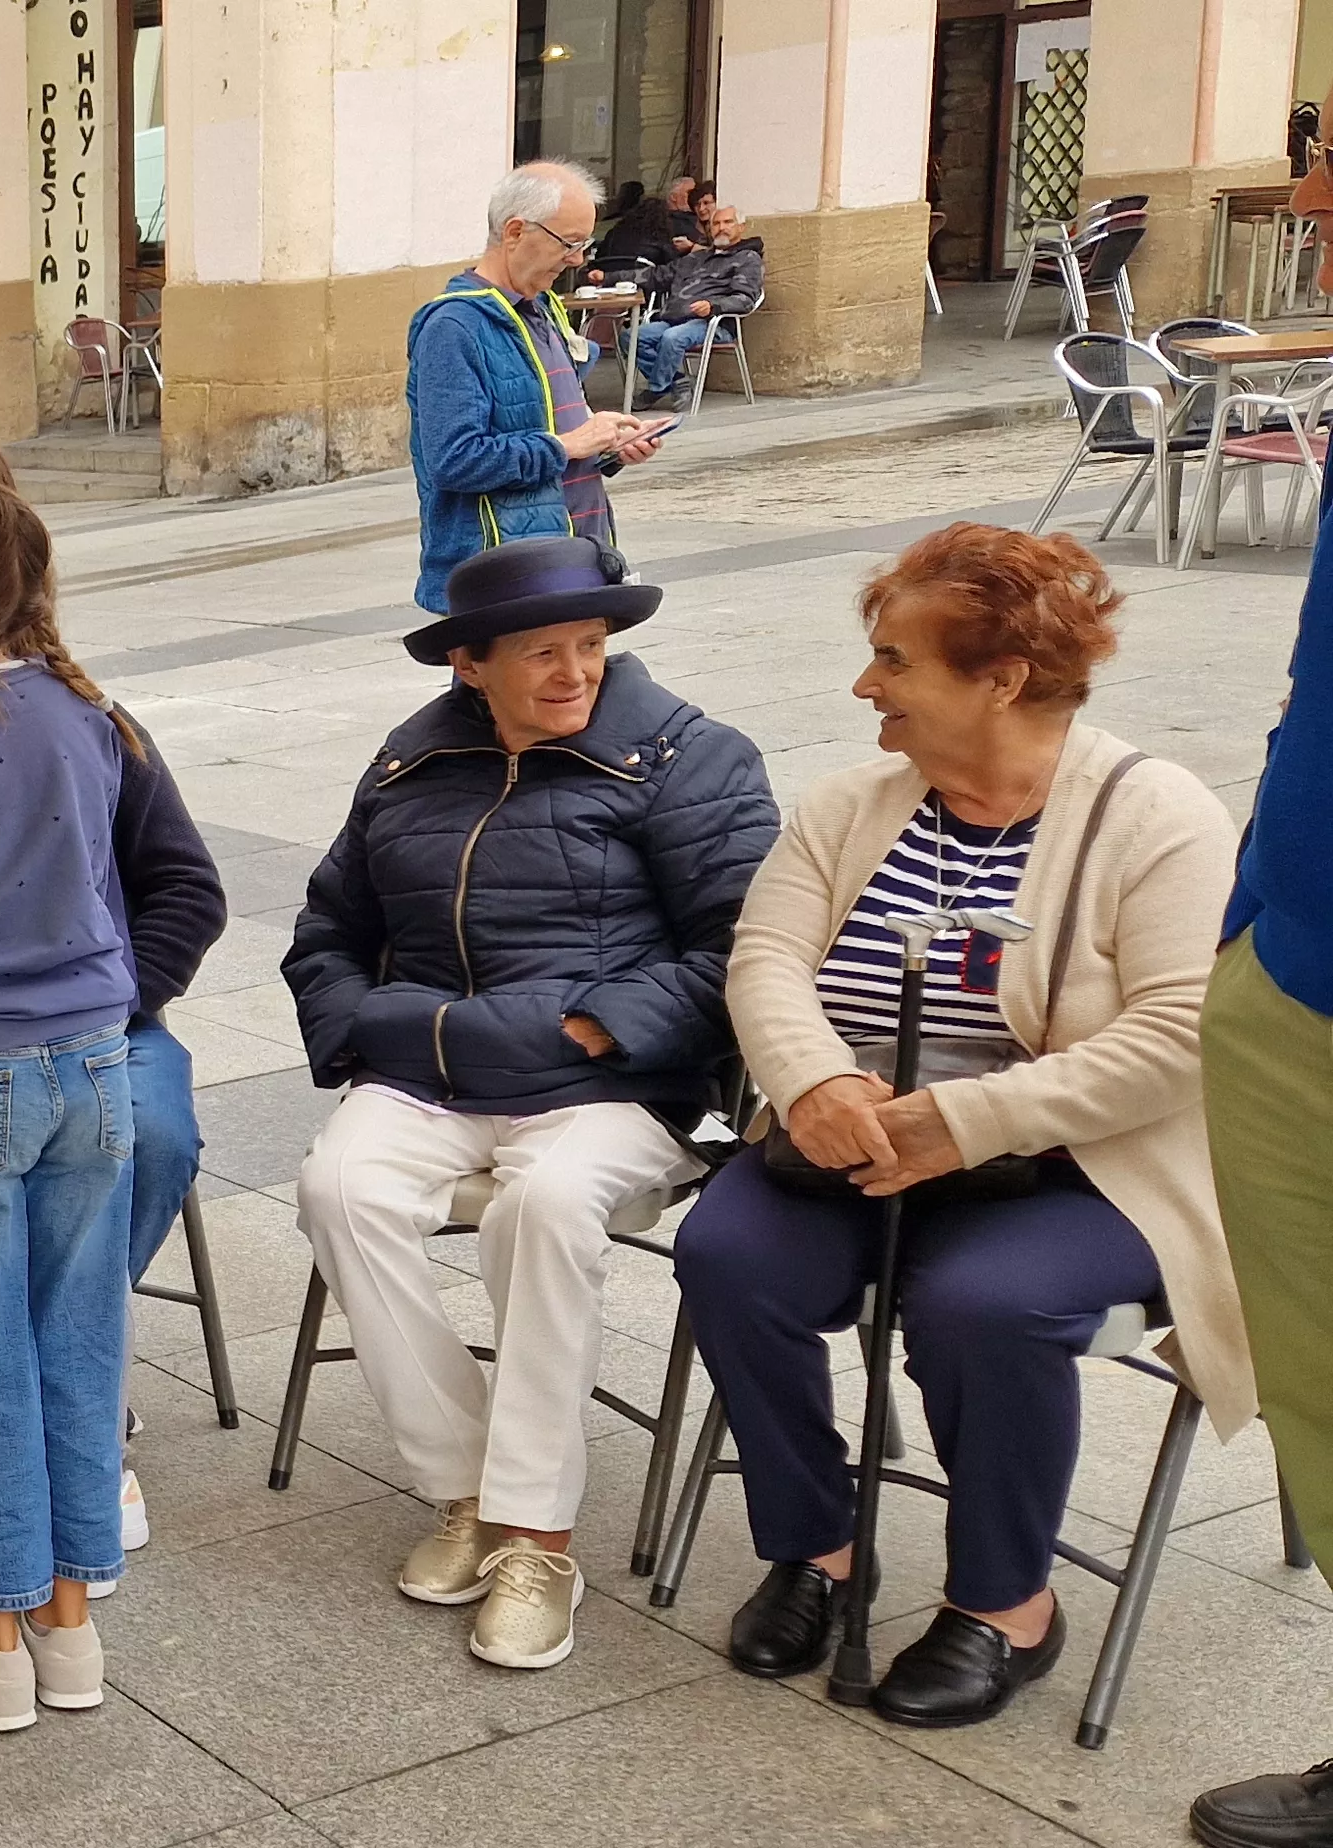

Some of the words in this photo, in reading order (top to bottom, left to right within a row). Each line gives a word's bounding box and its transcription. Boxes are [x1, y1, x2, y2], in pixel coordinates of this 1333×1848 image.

[69, 0, 89, 38] O
[76, 49, 95, 157] HAY
[40, 83, 58, 285] POESIA
[72, 171, 91, 320] CIUDA
